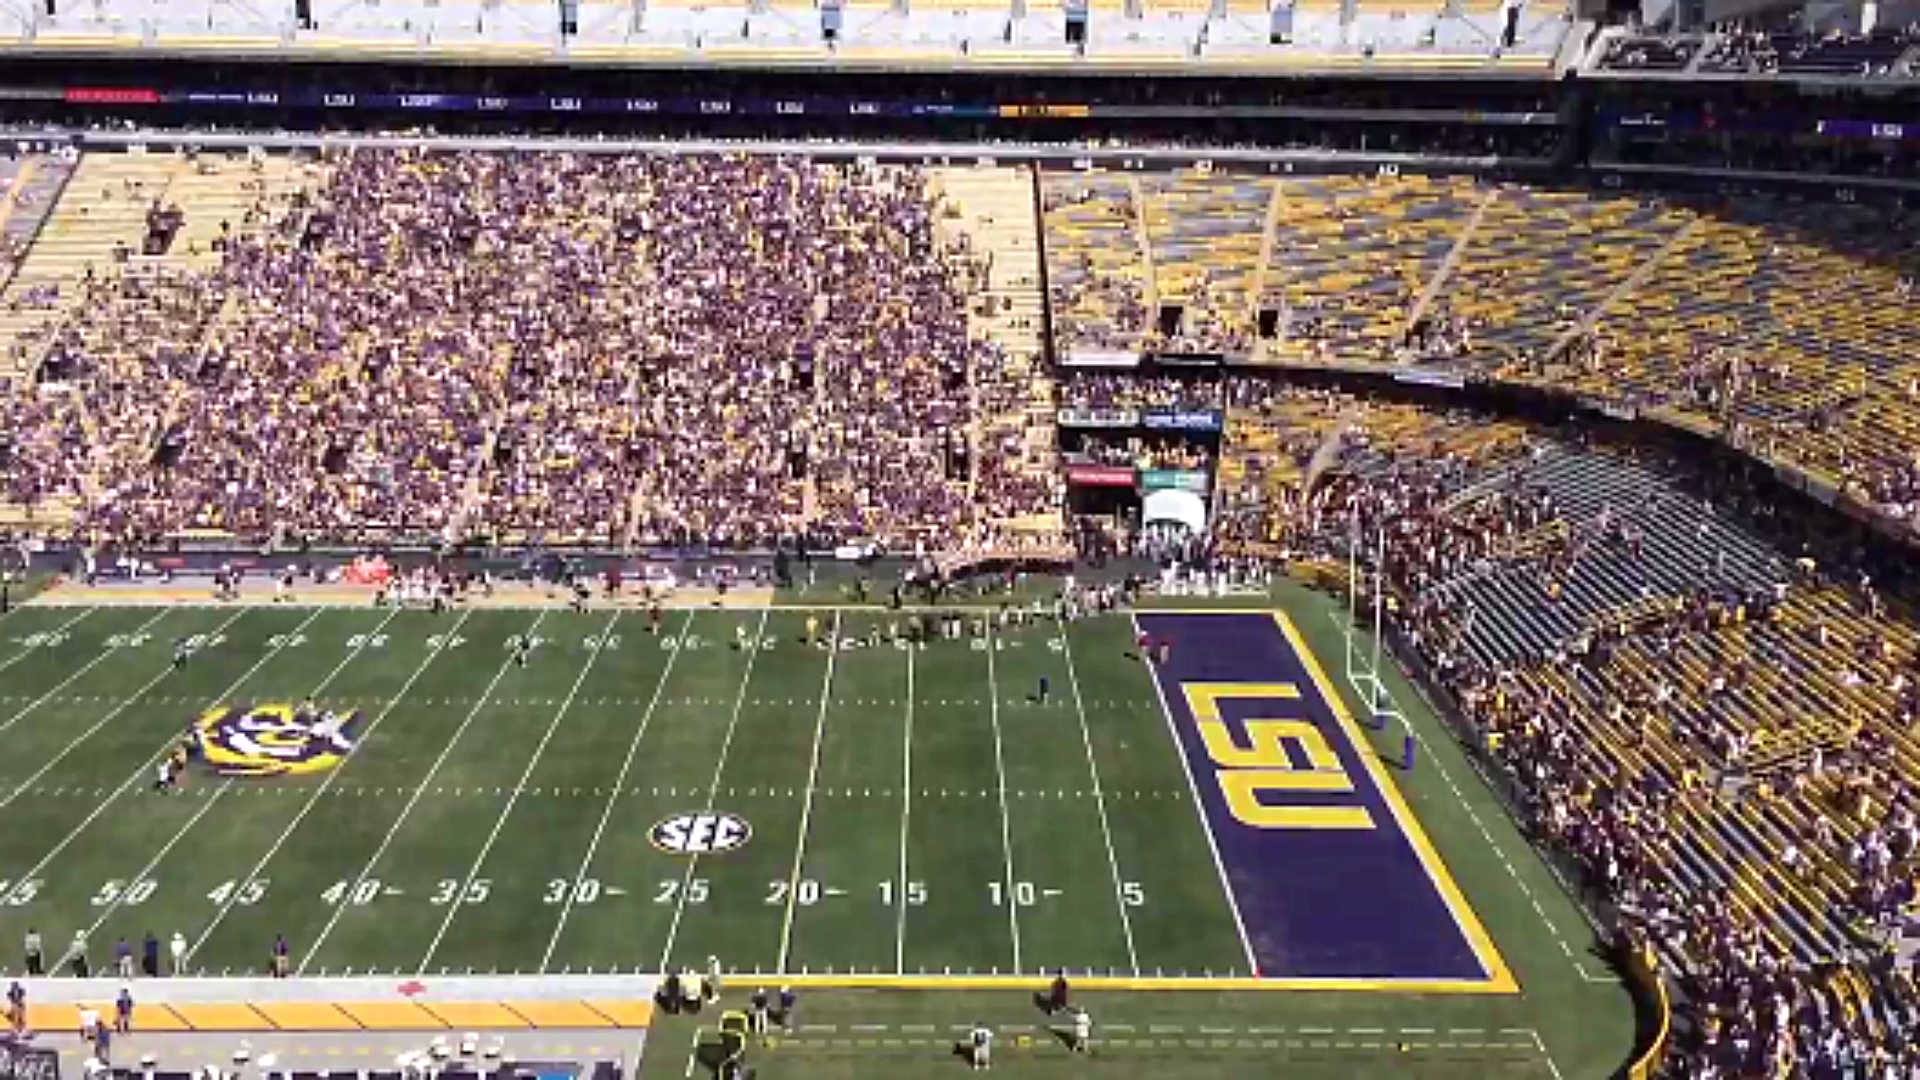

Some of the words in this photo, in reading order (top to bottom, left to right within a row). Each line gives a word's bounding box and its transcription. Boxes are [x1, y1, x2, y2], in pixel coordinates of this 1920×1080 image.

[1179, 682, 1377, 829] LSU
[660, 815, 744, 852] SEC
[91, 879, 157, 905] 50
[207, 879, 272, 905] 45
[321, 879, 381, 905] 40
[430, 879, 493, 905] 35
[543, 879, 601, 905] 30
[653, 879, 711, 905] 25
[764, 879, 820, 905] 20
[878, 879, 928, 905] 15
[989, 879, 1036, 905] 10
[1123, 879, 1145, 905] 5
